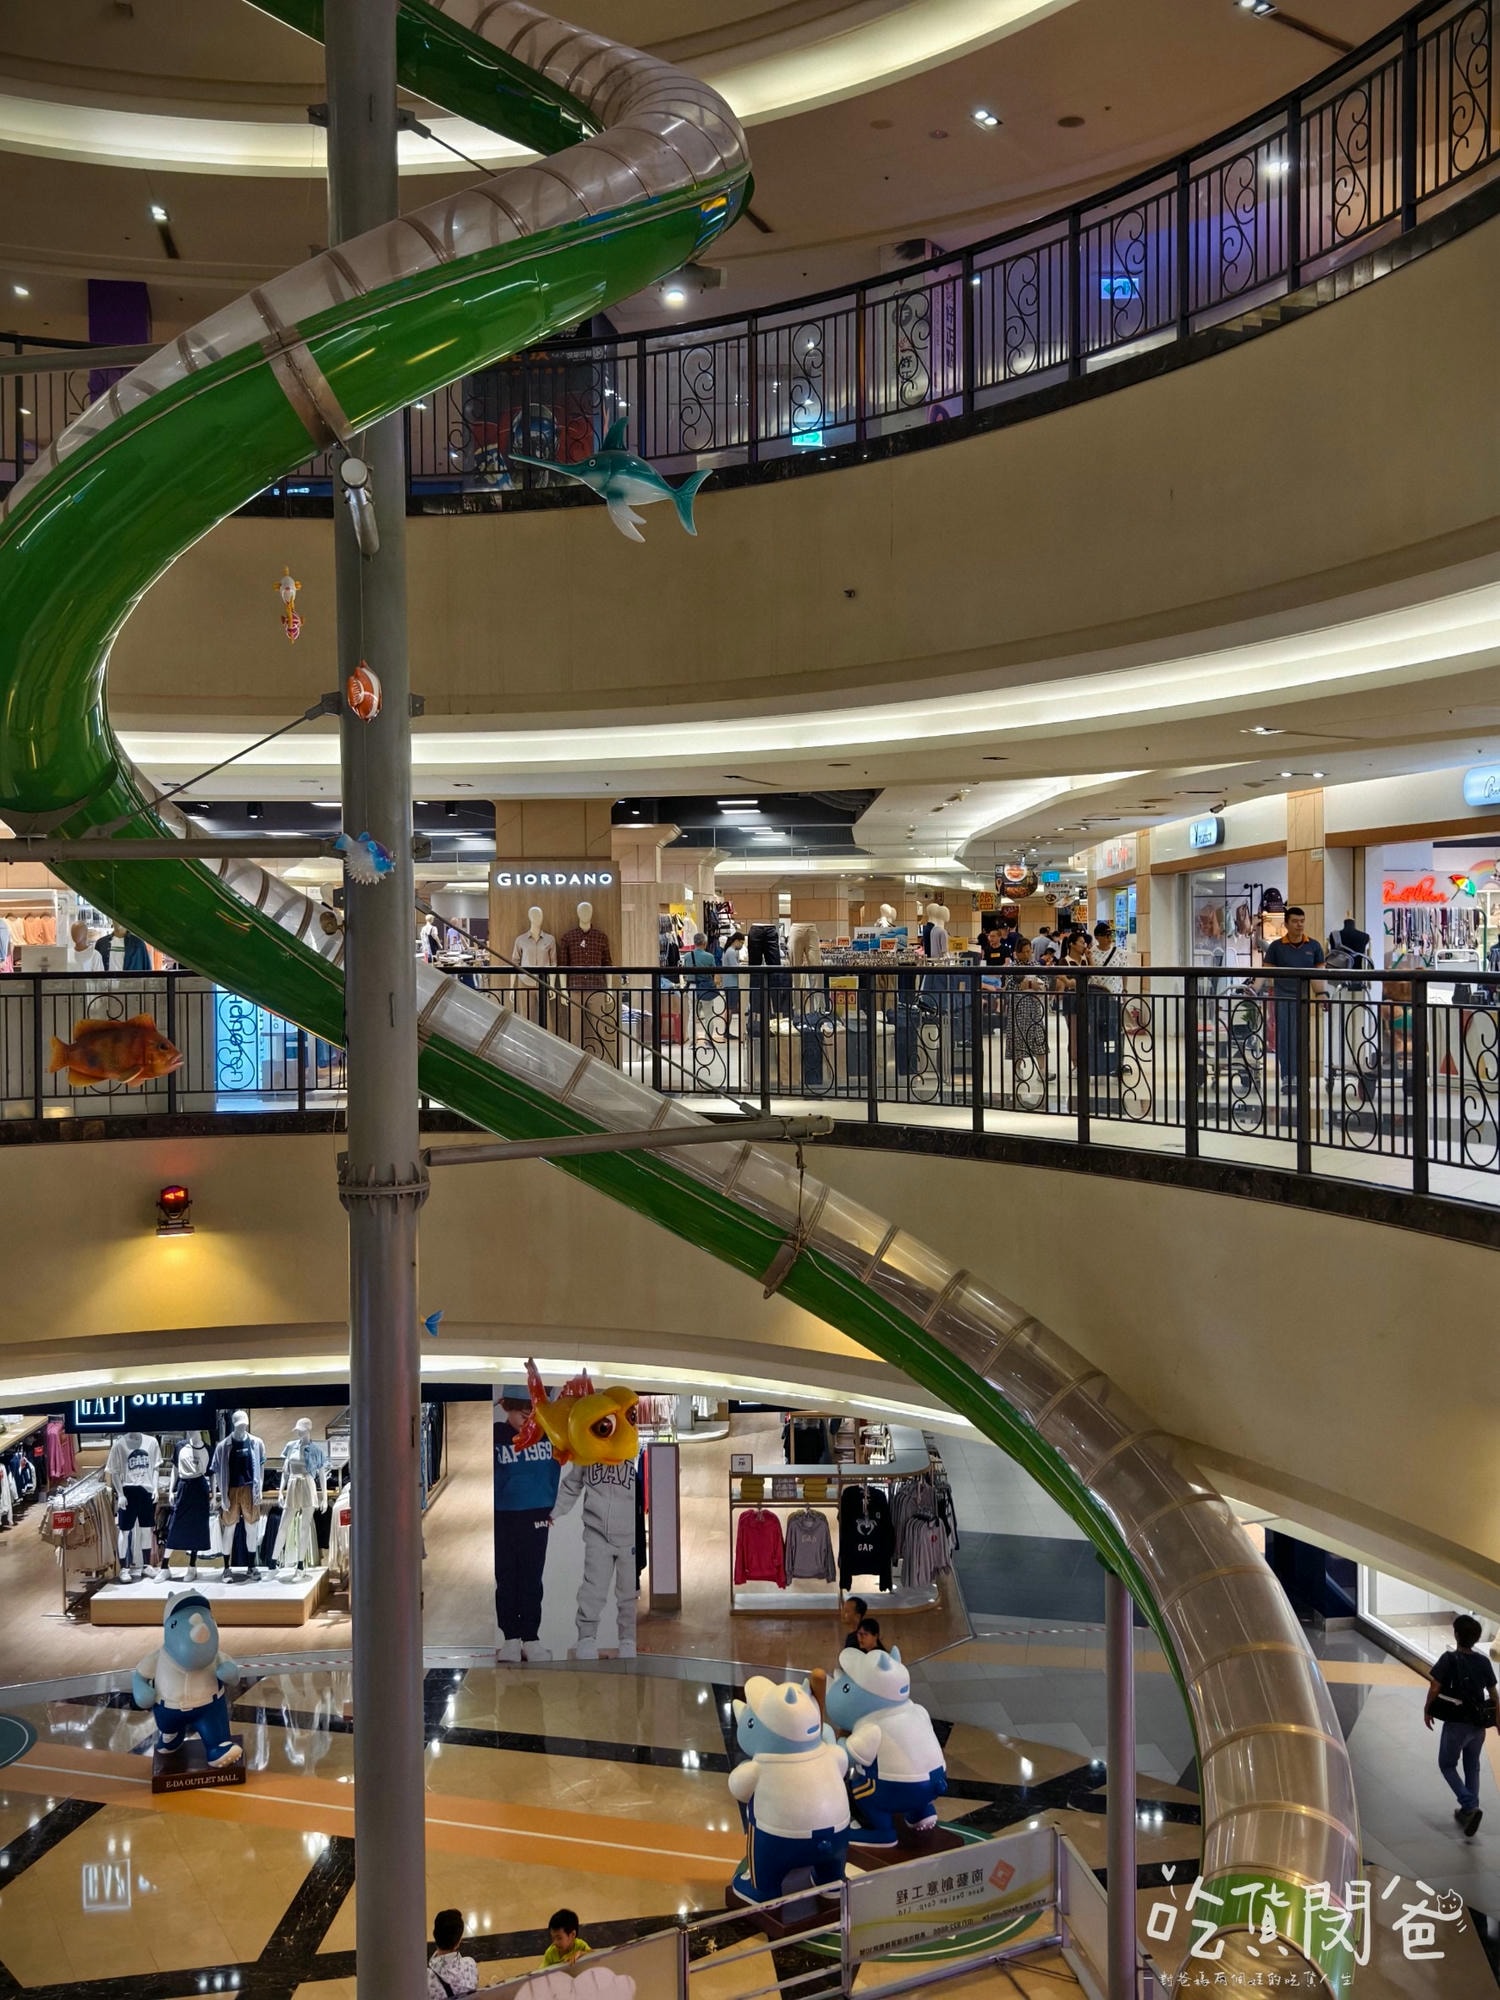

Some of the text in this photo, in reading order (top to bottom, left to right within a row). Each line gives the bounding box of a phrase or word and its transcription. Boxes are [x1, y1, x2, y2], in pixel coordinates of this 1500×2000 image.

[496, 872, 613, 887] GIORDANO
[81, 1392, 206, 1415] GAP OUTLET
[523, 1440, 552, 1461] 1969
[128, 1454, 150, 1469] GAP
[587, 1459, 636, 1490] GAP
[857, 1543, 874, 1552] GAP
[165, 1773, 239, 1789] E-DA OUTLET MALL
